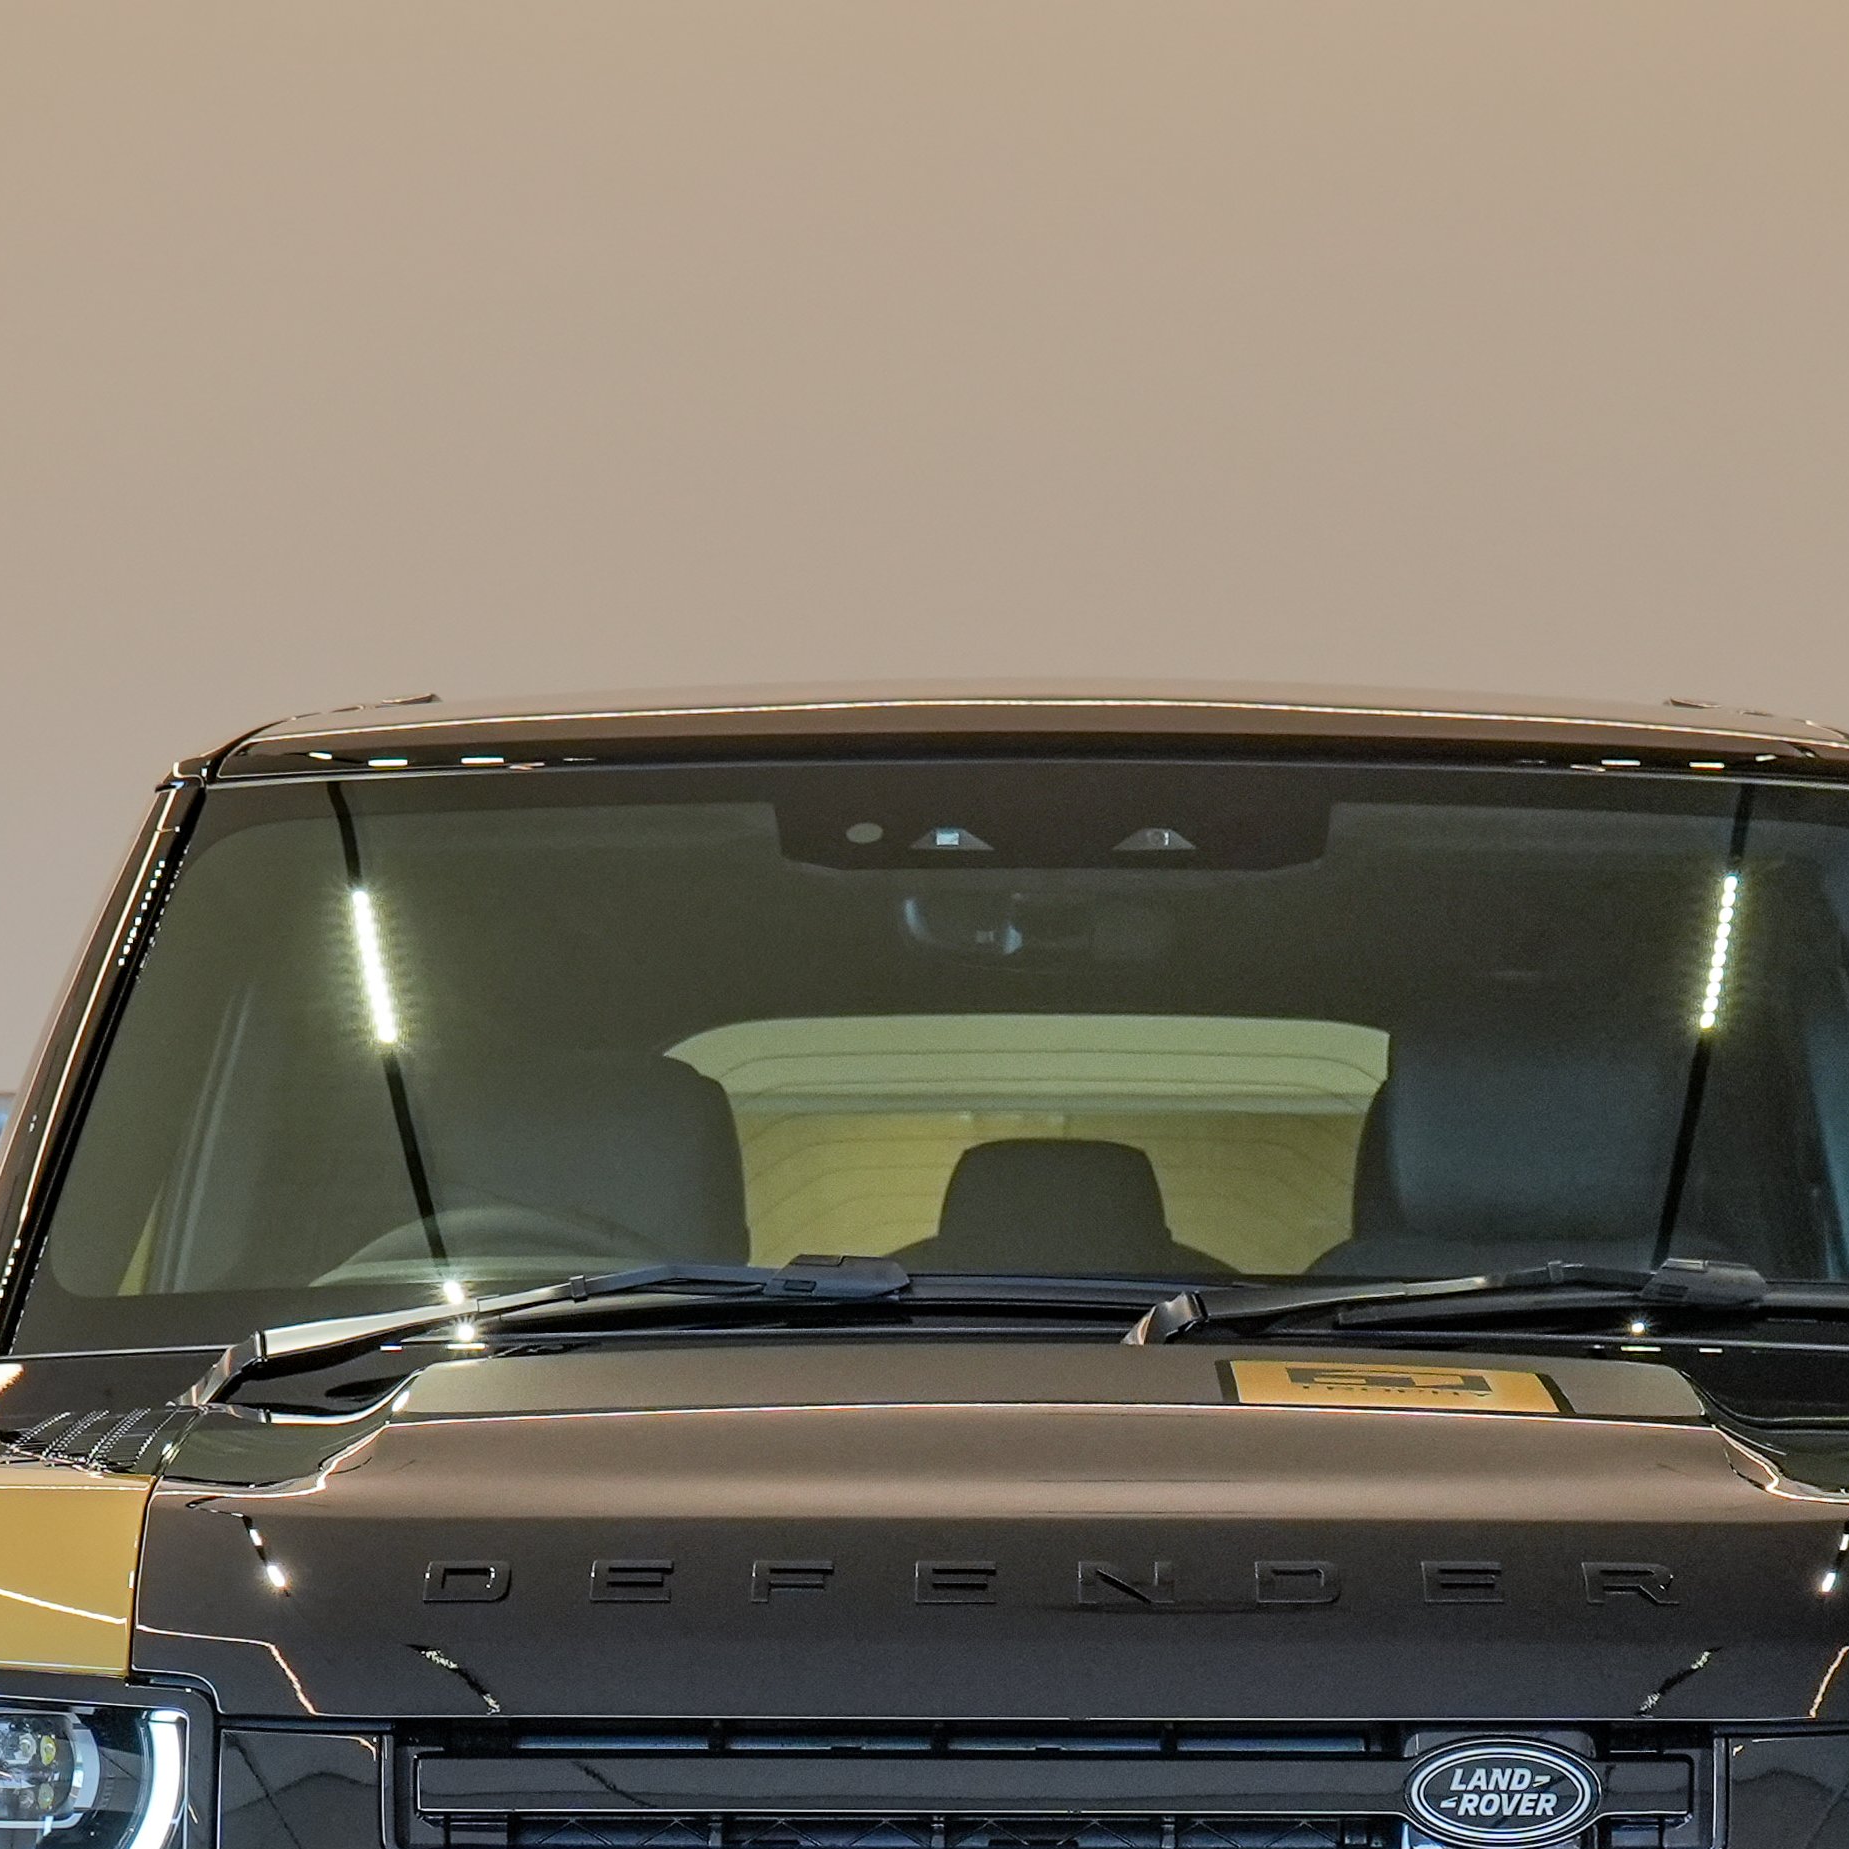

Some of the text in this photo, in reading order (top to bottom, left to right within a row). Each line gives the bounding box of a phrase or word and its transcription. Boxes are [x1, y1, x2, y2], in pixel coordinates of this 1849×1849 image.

[422, 1559, 1680, 1604] DEFENDER
[1449, 1767, 1533, 1791] LAND
[1457, 1793, 1559, 1816] ROVER
